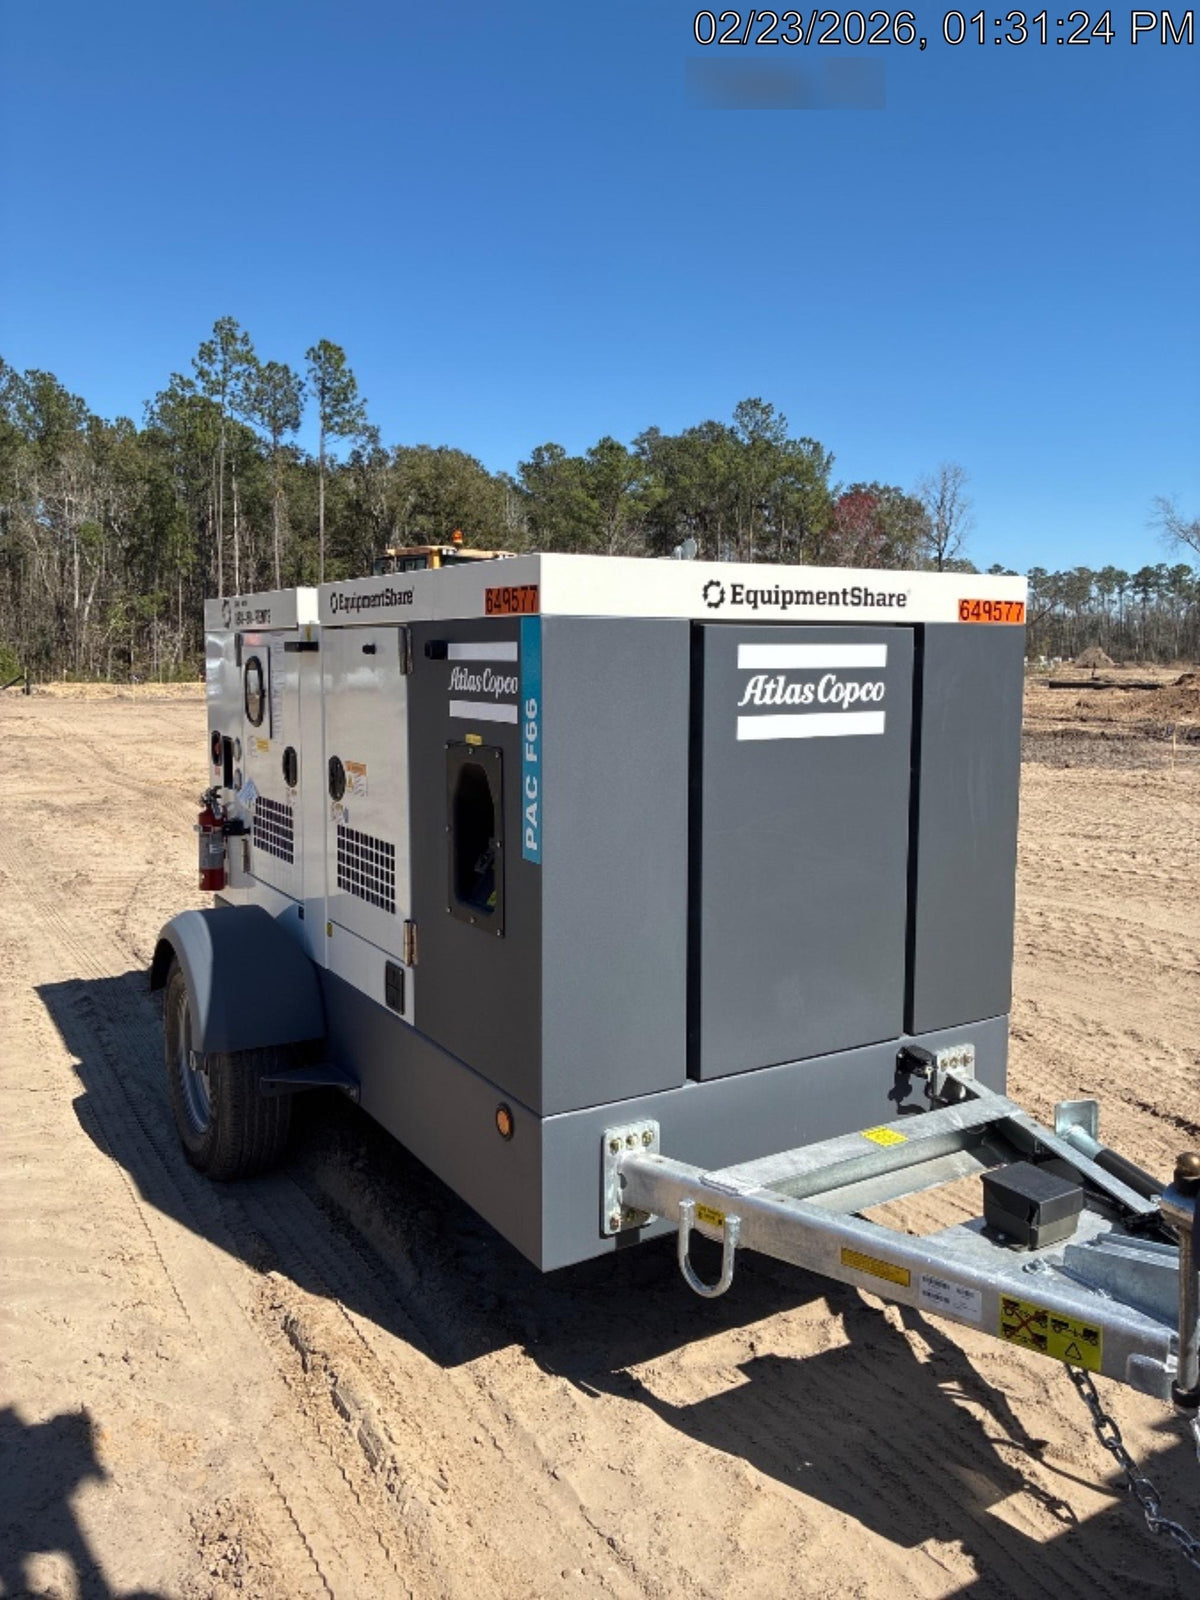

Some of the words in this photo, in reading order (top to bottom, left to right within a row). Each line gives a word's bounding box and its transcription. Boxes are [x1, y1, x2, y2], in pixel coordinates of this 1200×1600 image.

[338, 587, 414, 614] EquipmentShare
[485, 585, 538, 614] 649577
[730, 584, 908, 610] EquipmentShare
[959, 600, 1025, 622] 649577
[448, 666, 481, 692] Atlas
[482, 668, 518, 698] Copco
[737, 675, 814, 707] Atlas
[817, 673, 885, 709] Copco
[525, 698, 538, 762] F66
[525, 775, 538, 851] PAC
